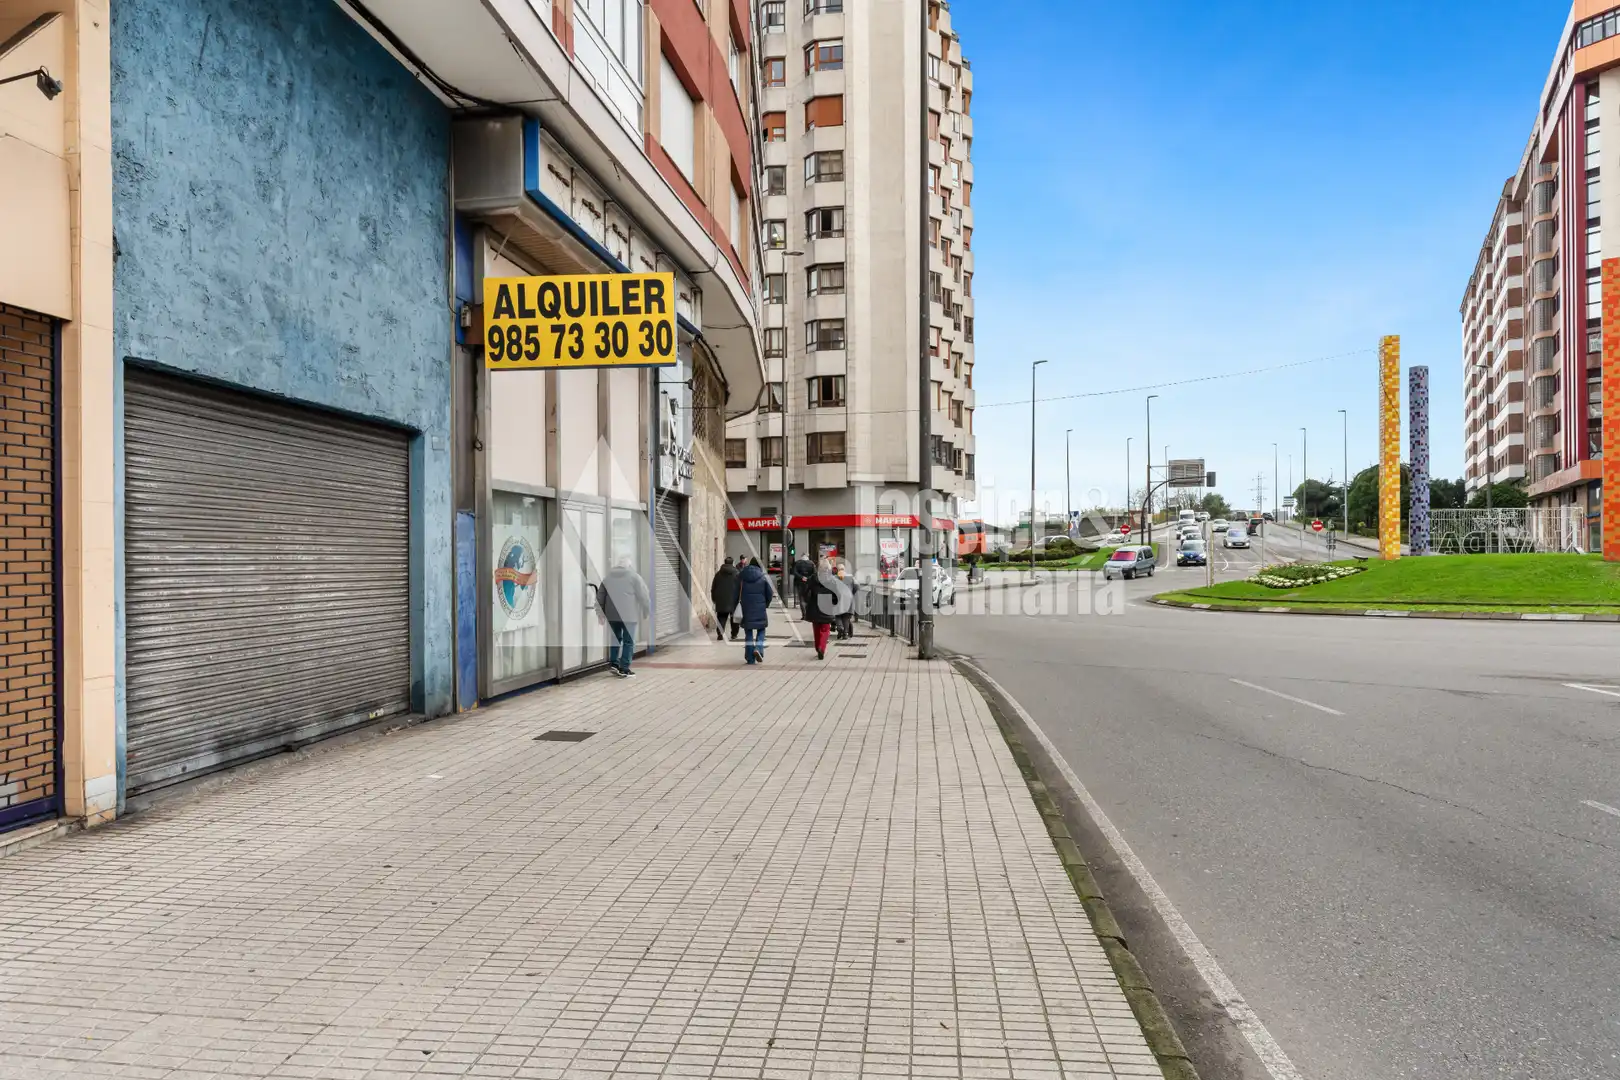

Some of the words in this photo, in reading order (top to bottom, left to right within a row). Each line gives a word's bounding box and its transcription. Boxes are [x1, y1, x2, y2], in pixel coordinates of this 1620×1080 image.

[493, 279, 666, 320] ALQUILER
[488, 324, 540, 361] 985
[550, 322, 584, 359] 73
[595, 321, 629, 358] 30
[639, 320, 673, 357] 30
[748, 519, 780, 528] MAPFR
[875, 516, 913, 525] MAPFRE
